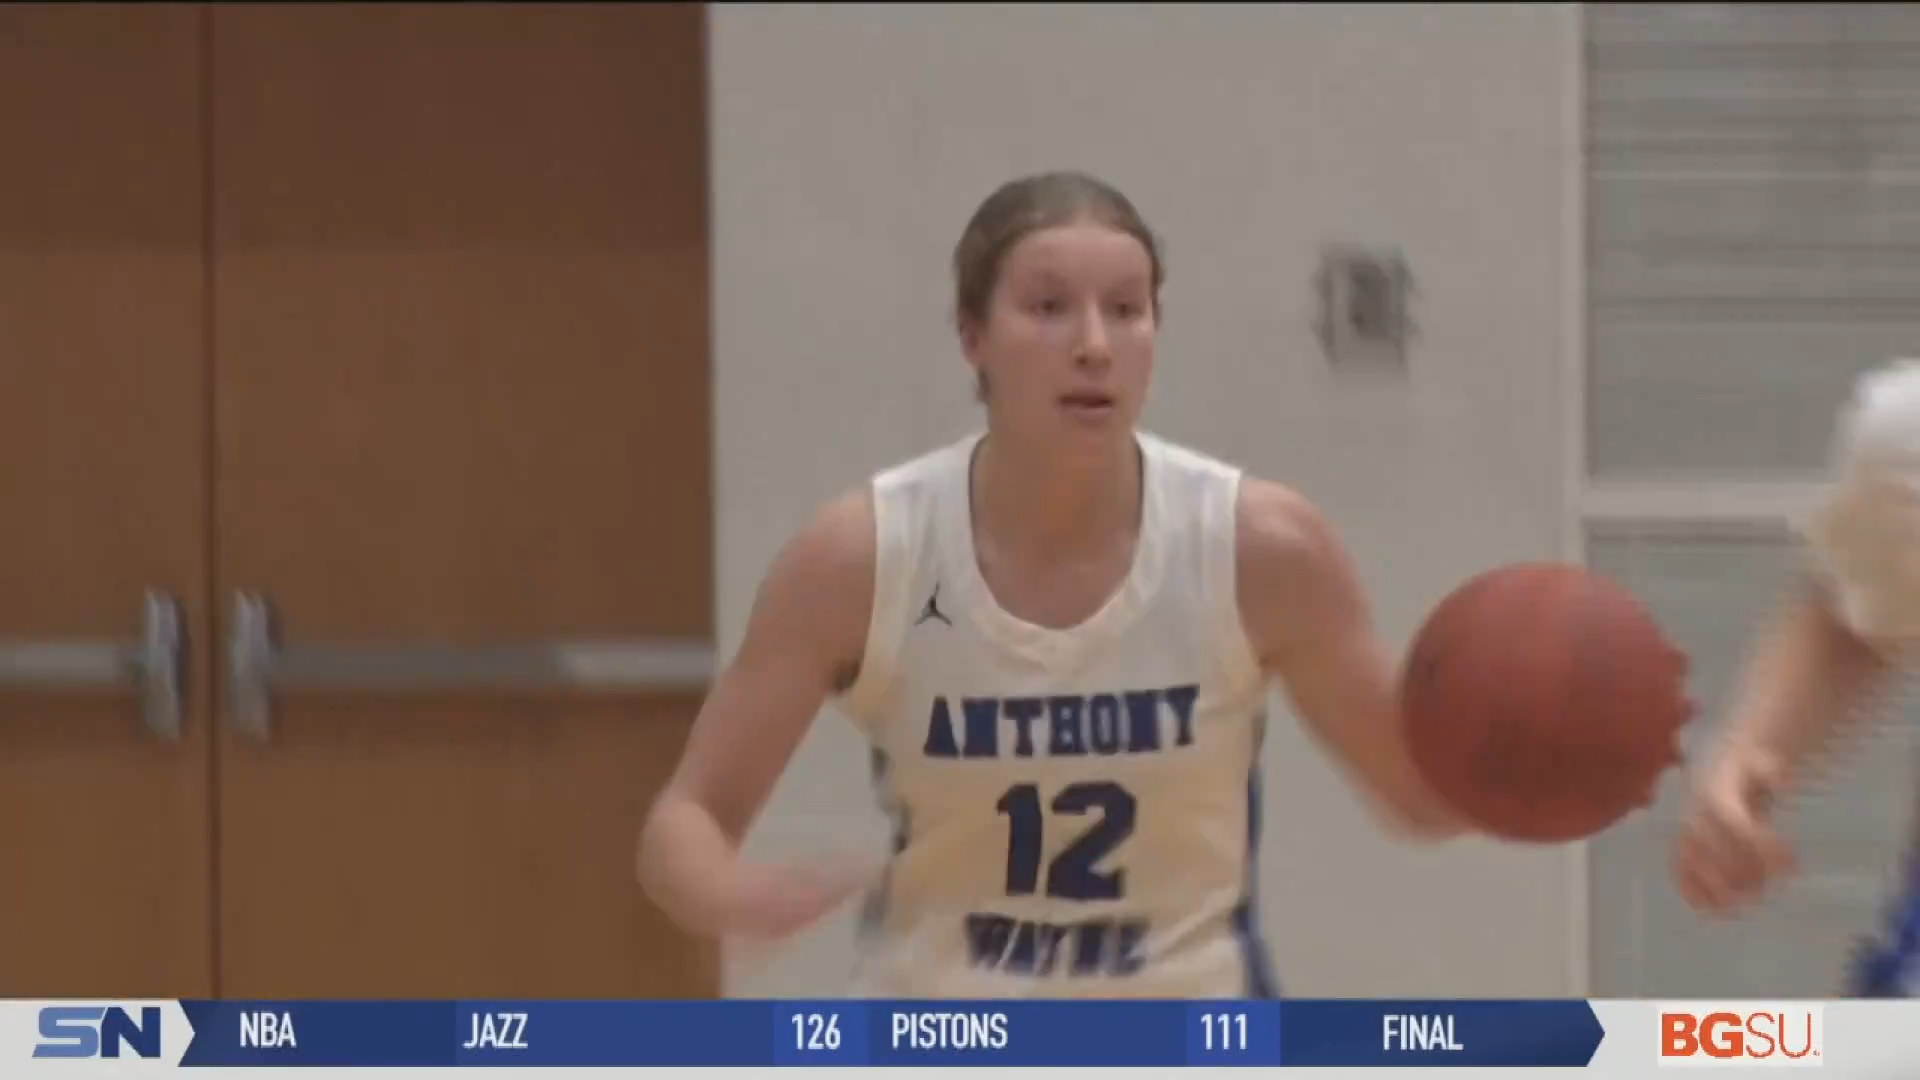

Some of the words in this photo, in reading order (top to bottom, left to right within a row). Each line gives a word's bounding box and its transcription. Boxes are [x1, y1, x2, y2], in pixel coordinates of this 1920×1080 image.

[924, 684, 1200, 757] ANTHONY
[997, 781, 1136, 900] 12
[964, 911, 1150, 976] WAYNE
